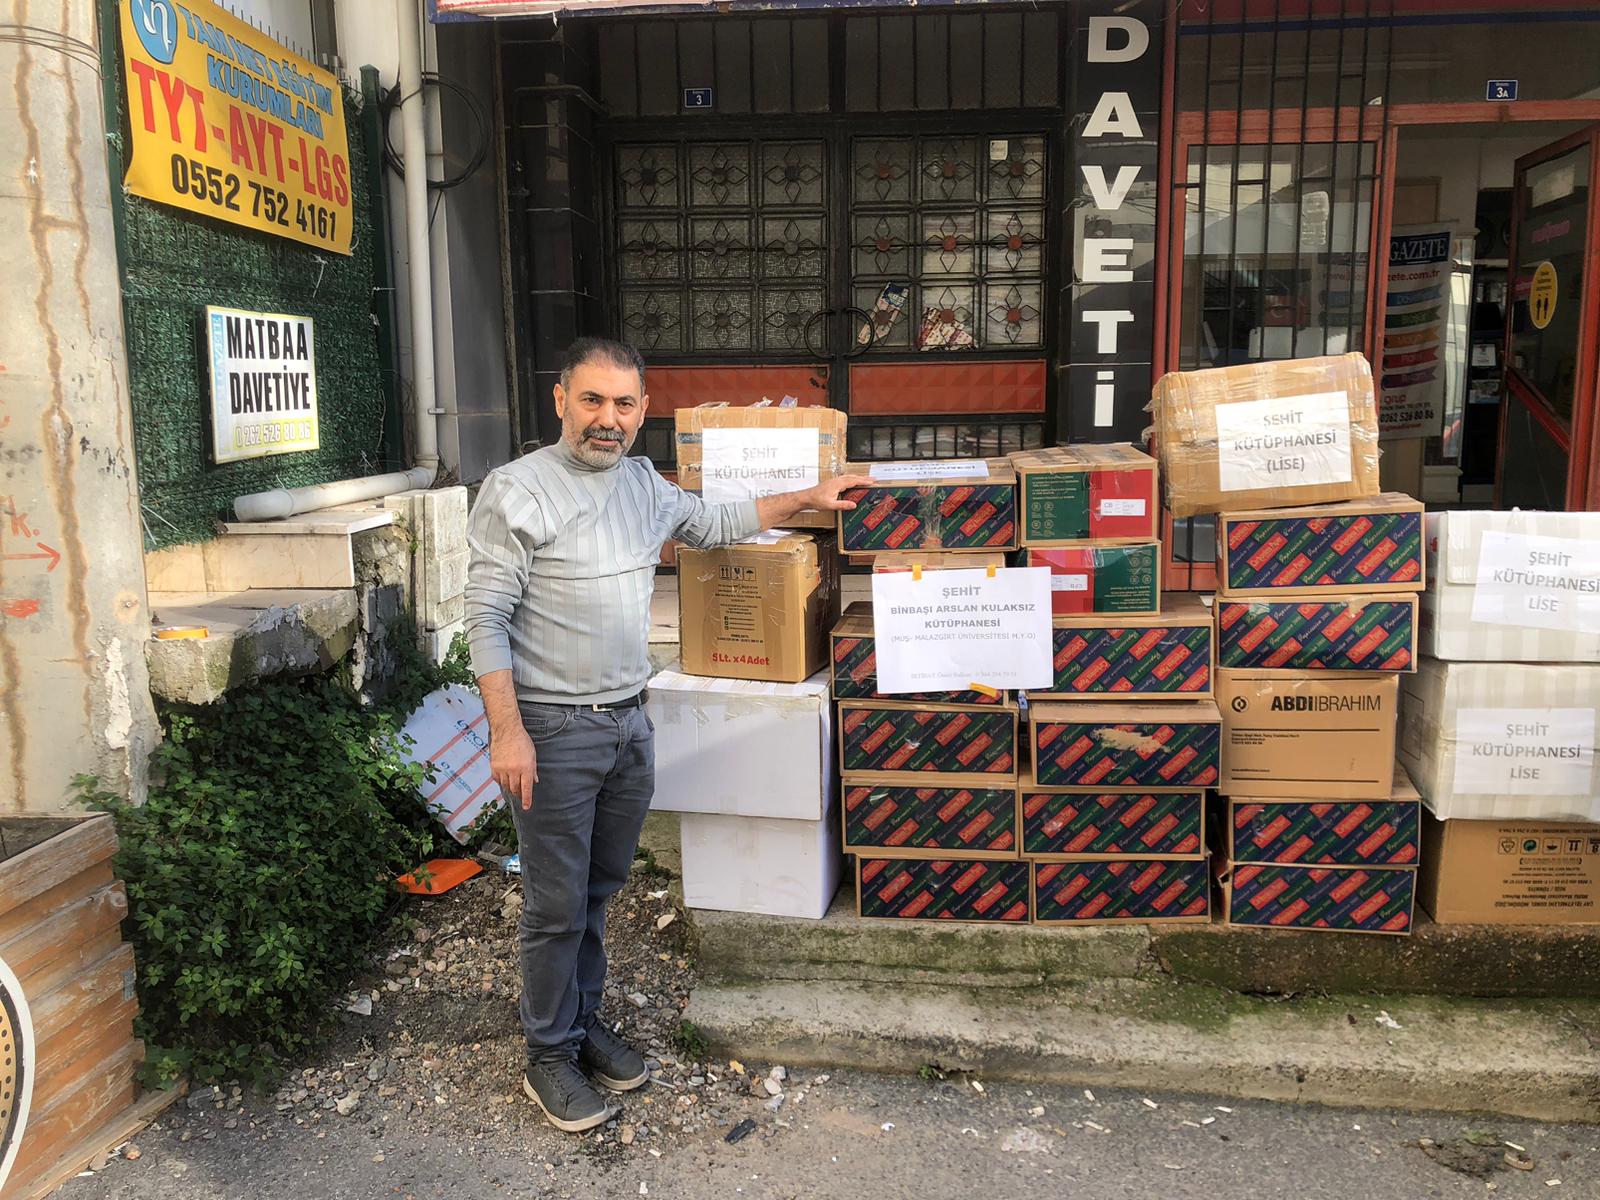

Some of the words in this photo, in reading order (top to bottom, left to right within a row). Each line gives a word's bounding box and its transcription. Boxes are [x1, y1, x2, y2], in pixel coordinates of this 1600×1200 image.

[176, 3, 234, 60] TAM
[207, 53, 324, 140] KURUMLARI
[696, 94, 702, 105] 3
[1496, 86, 1508, 98] 3A
[171, 153, 240, 211] 0552
[248, 181, 289, 228] 752
[297, 199, 336, 242] 4161
[1389, 236, 1448, 261] GAZETE
[226, 316, 308, 360] MATBAA
[229, 365, 310, 414] DAVETİYE
[264, 422, 280, 443] 526
[1235, 429, 1336, 451] KÜTÜPHANESİ
[742, 445, 778, 461] ŞEHİT
[714, 466, 806, 480] KÜTÜPHANESİ
[1267, 456, 1305, 474] (LİSE)
[1528, 551, 1572, 567] ŞEHİT
[1494, 569, 1600, 593] KÜTÜPHANESİ
[942, 585, 981, 599] ŞEHİT
[891, 604, 933, 616] BİNBAŞI
[936, 604, 978, 613] ARSLAN
[981, 603, 1035, 612] KULAKSIZ
[1529, 596, 1559, 612] LİSE
[925, 618, 1000, 629] KÜTÜPHANESİ
[915, 632, 955, 641] MALAZGİRT
[958, 631, 1009, 640] ÜNİVERSİTESİ
[1506, 722, 1549, 738] ŞEHİT
[1472, 742, 1581, 758] KÜTÜPHANESİ
[1510, 766, 1540, 779] LİSE
